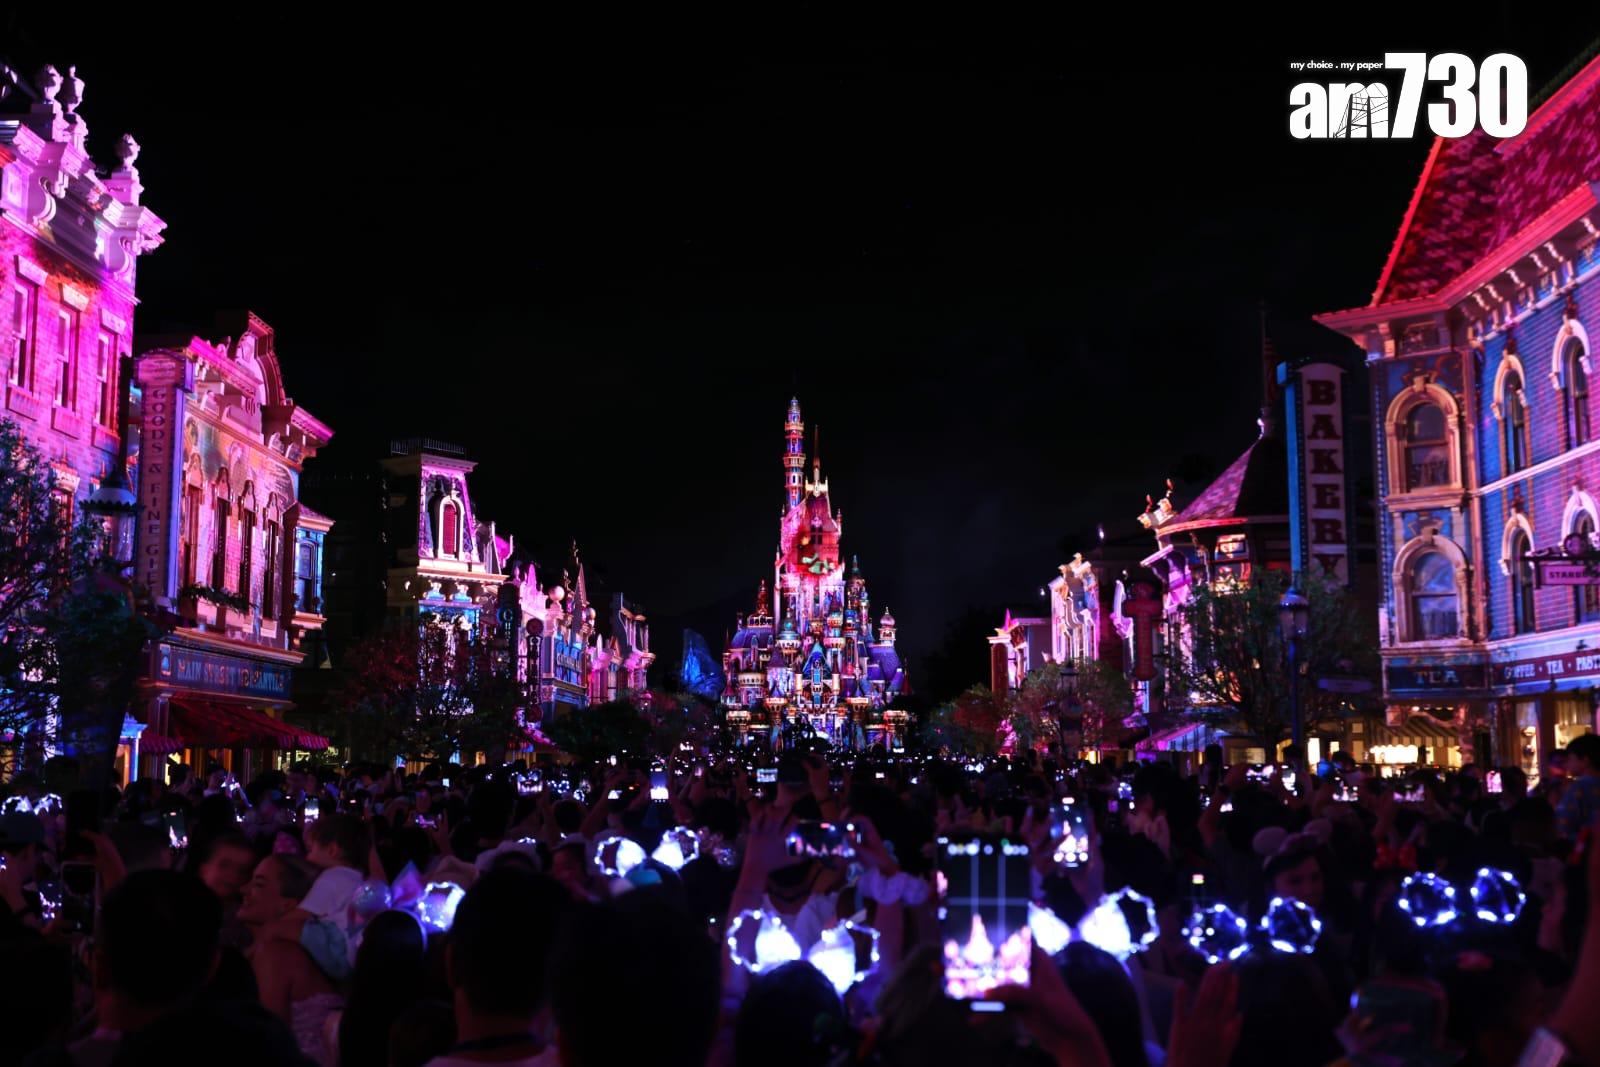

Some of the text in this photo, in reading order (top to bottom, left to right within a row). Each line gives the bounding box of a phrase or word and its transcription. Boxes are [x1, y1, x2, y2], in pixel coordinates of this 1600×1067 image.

[152, 389, 165, 453] GOODS
[1307, 380, 1345, 580] BAKERY
[148, 483, 160, 534] FINE
[146, 544, 160, 588] GIF
[1549, 571, 1588, 579] STARBU
[1545, 659, 1564, 675] TEA
[1575, 654, 1600, 671] PAST
